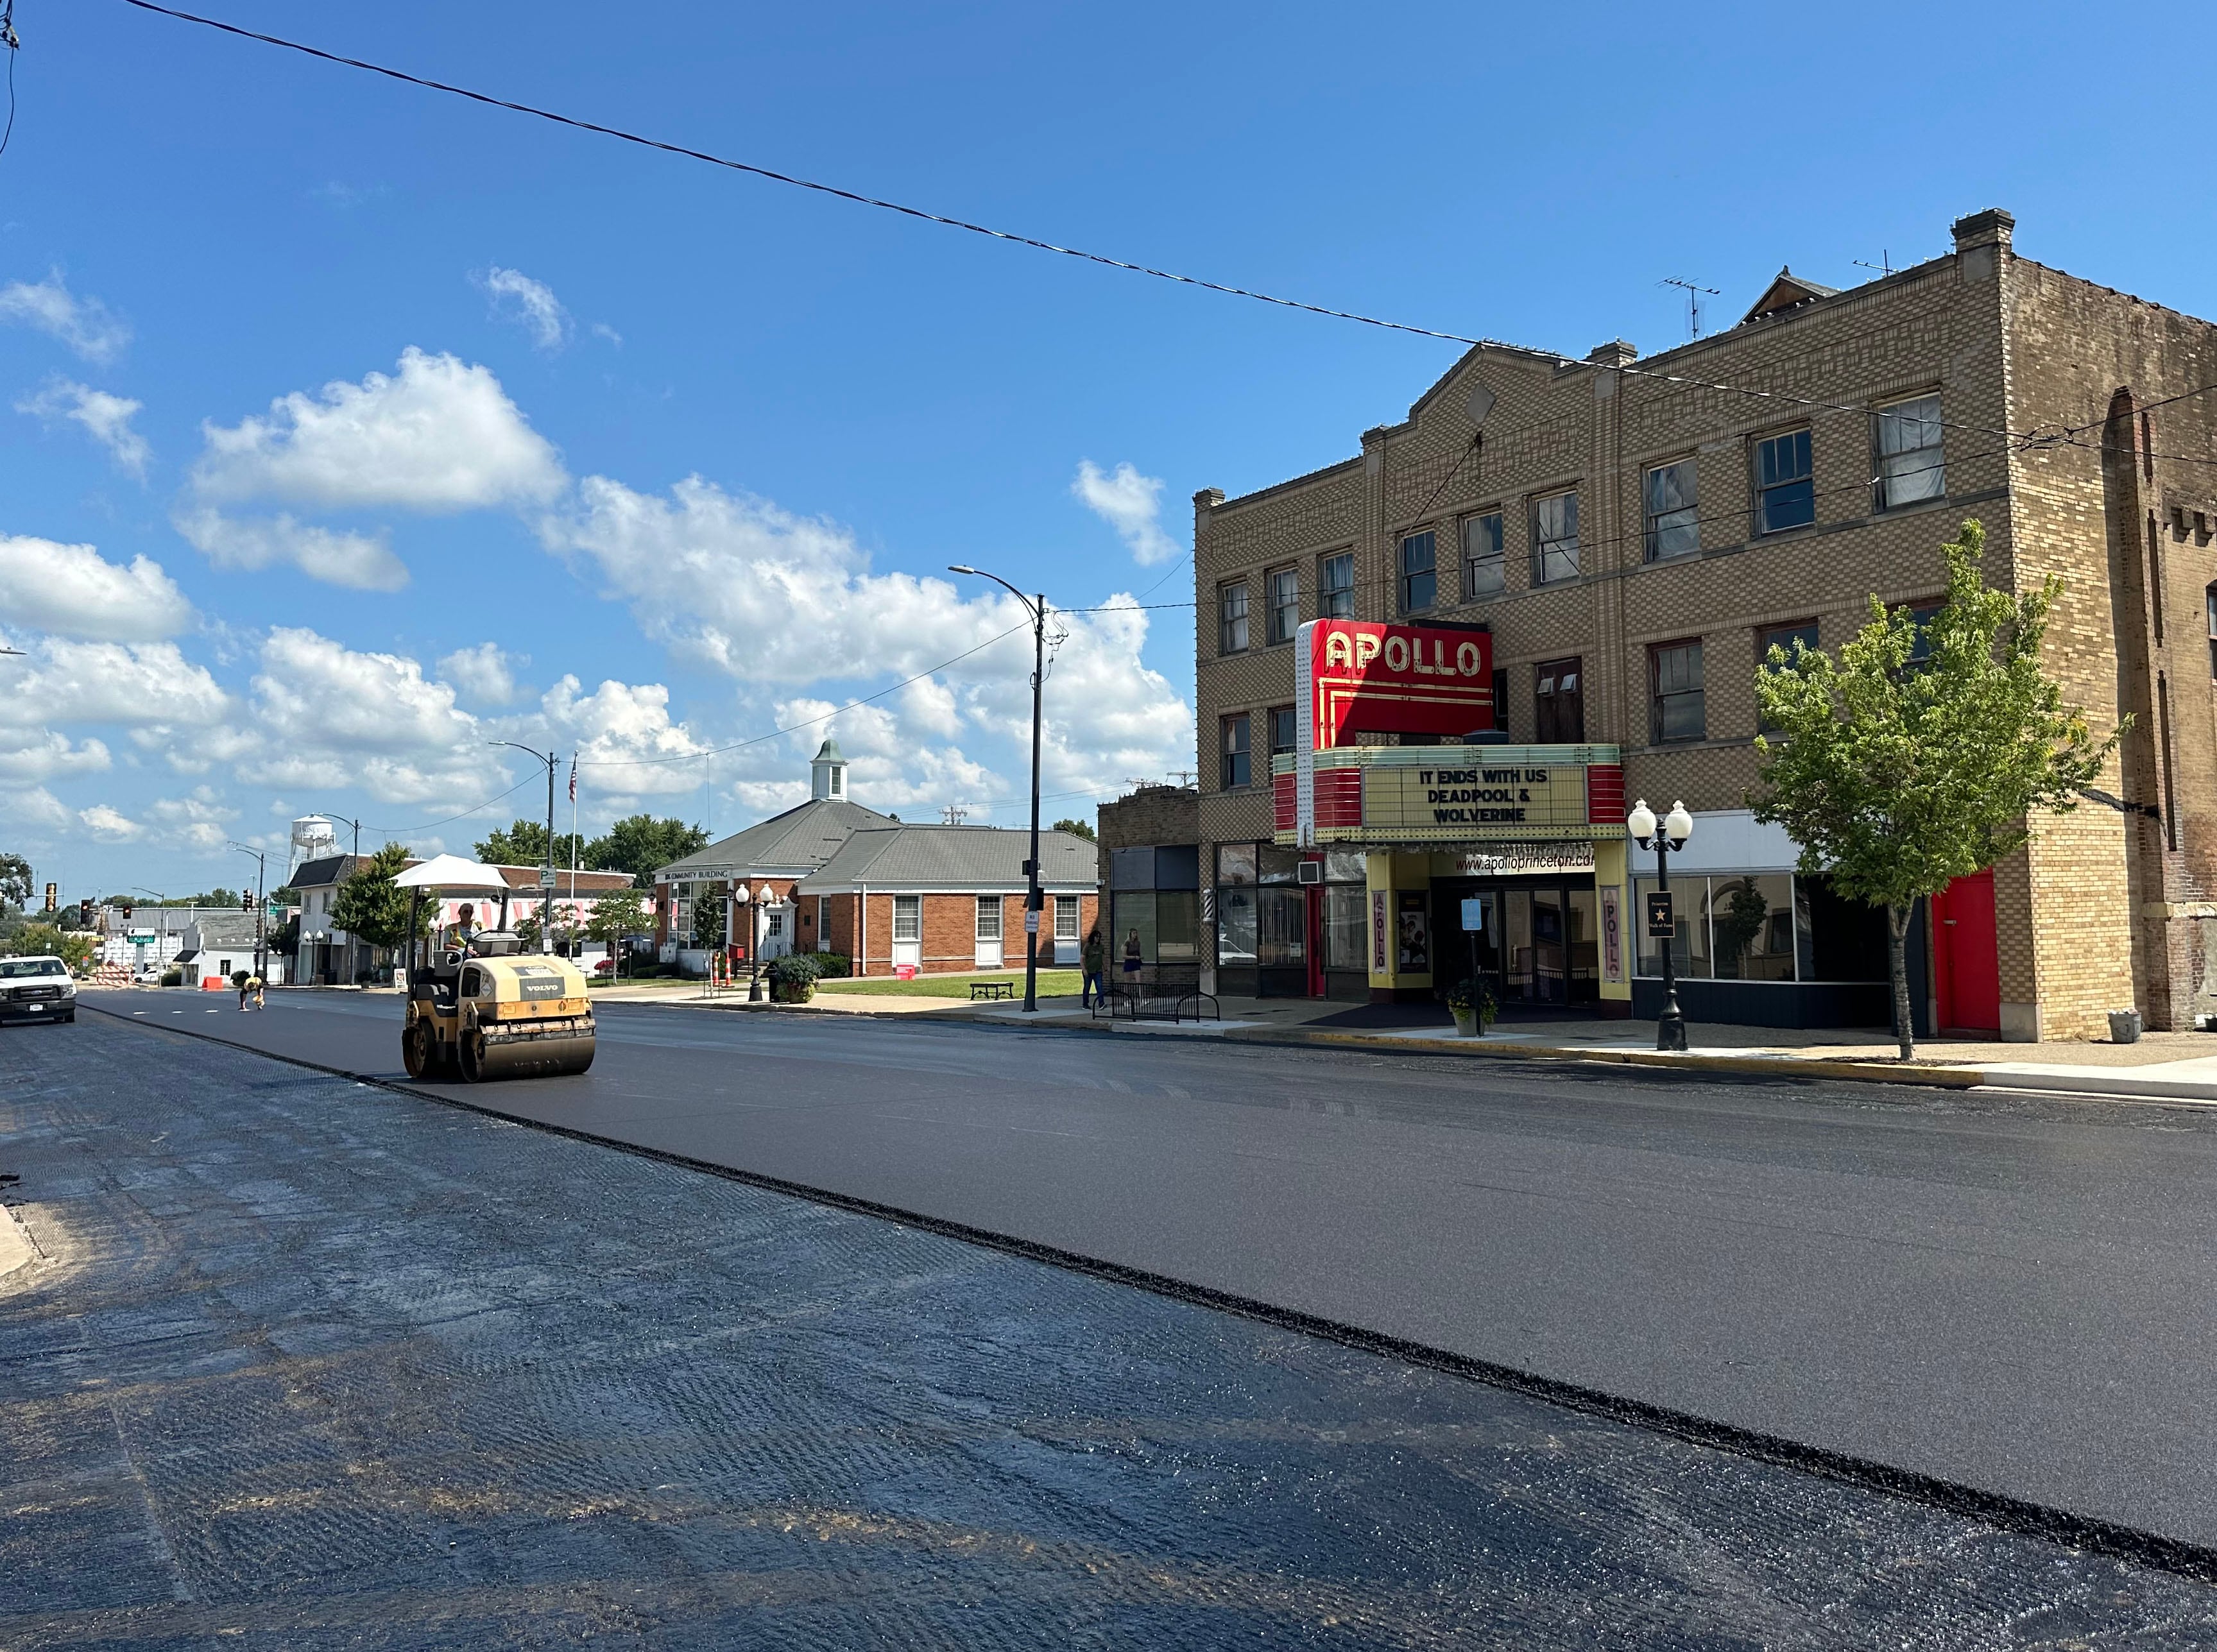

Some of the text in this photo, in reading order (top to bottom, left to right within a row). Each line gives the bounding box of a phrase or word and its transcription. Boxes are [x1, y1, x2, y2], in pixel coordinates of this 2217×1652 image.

[1326, 631, 1481, 677] APOLLO
[1420, 769, 1548, 784] IT ENDS WITH US
[1428, 788, 1530, 803] DEADPOOL &
[1434, 808, 1526, 822] WOLVERINE
[698, 870, 728, 878] BUILDING
[1605, 890, 1618, 976] APOLLO
